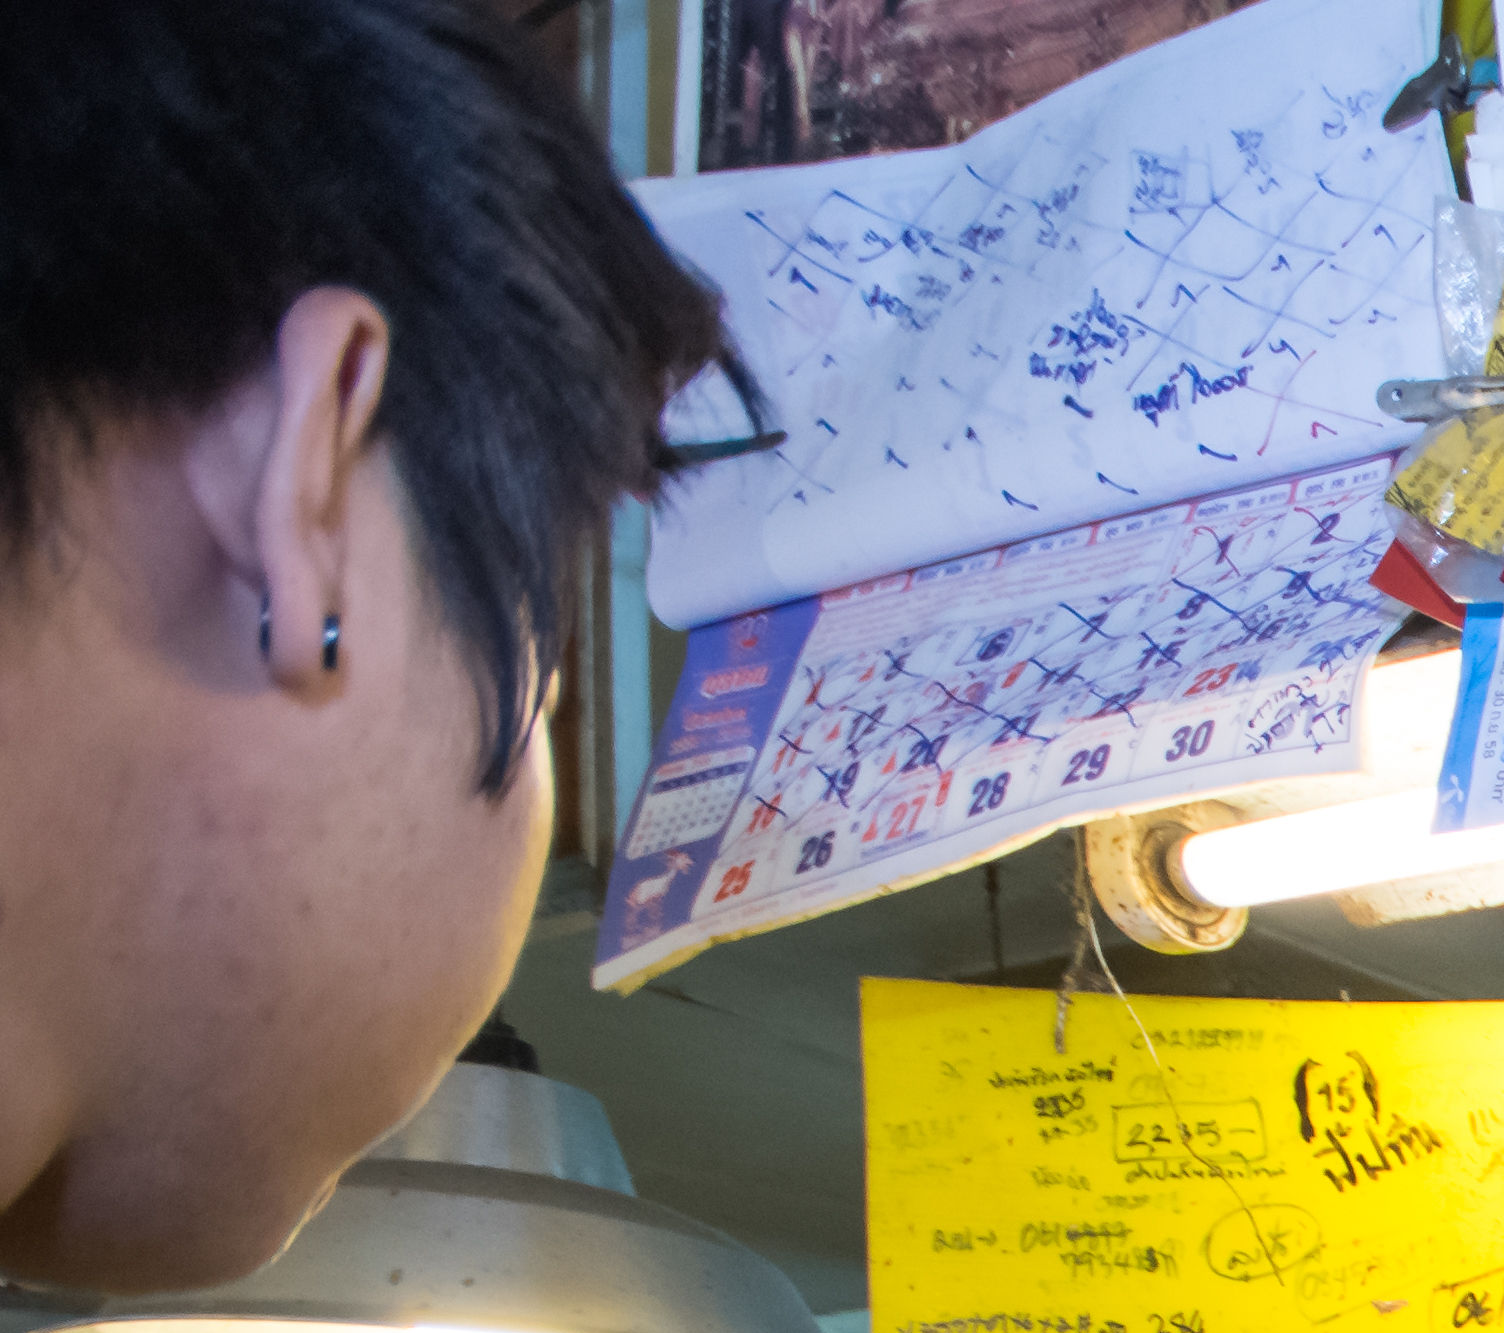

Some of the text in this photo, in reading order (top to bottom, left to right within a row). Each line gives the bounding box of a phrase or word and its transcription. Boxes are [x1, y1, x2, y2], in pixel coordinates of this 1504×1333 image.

[1183, 663, 1239, 697] 23
[714, 720, 1214, 902] 25 26 27 28 29 30
